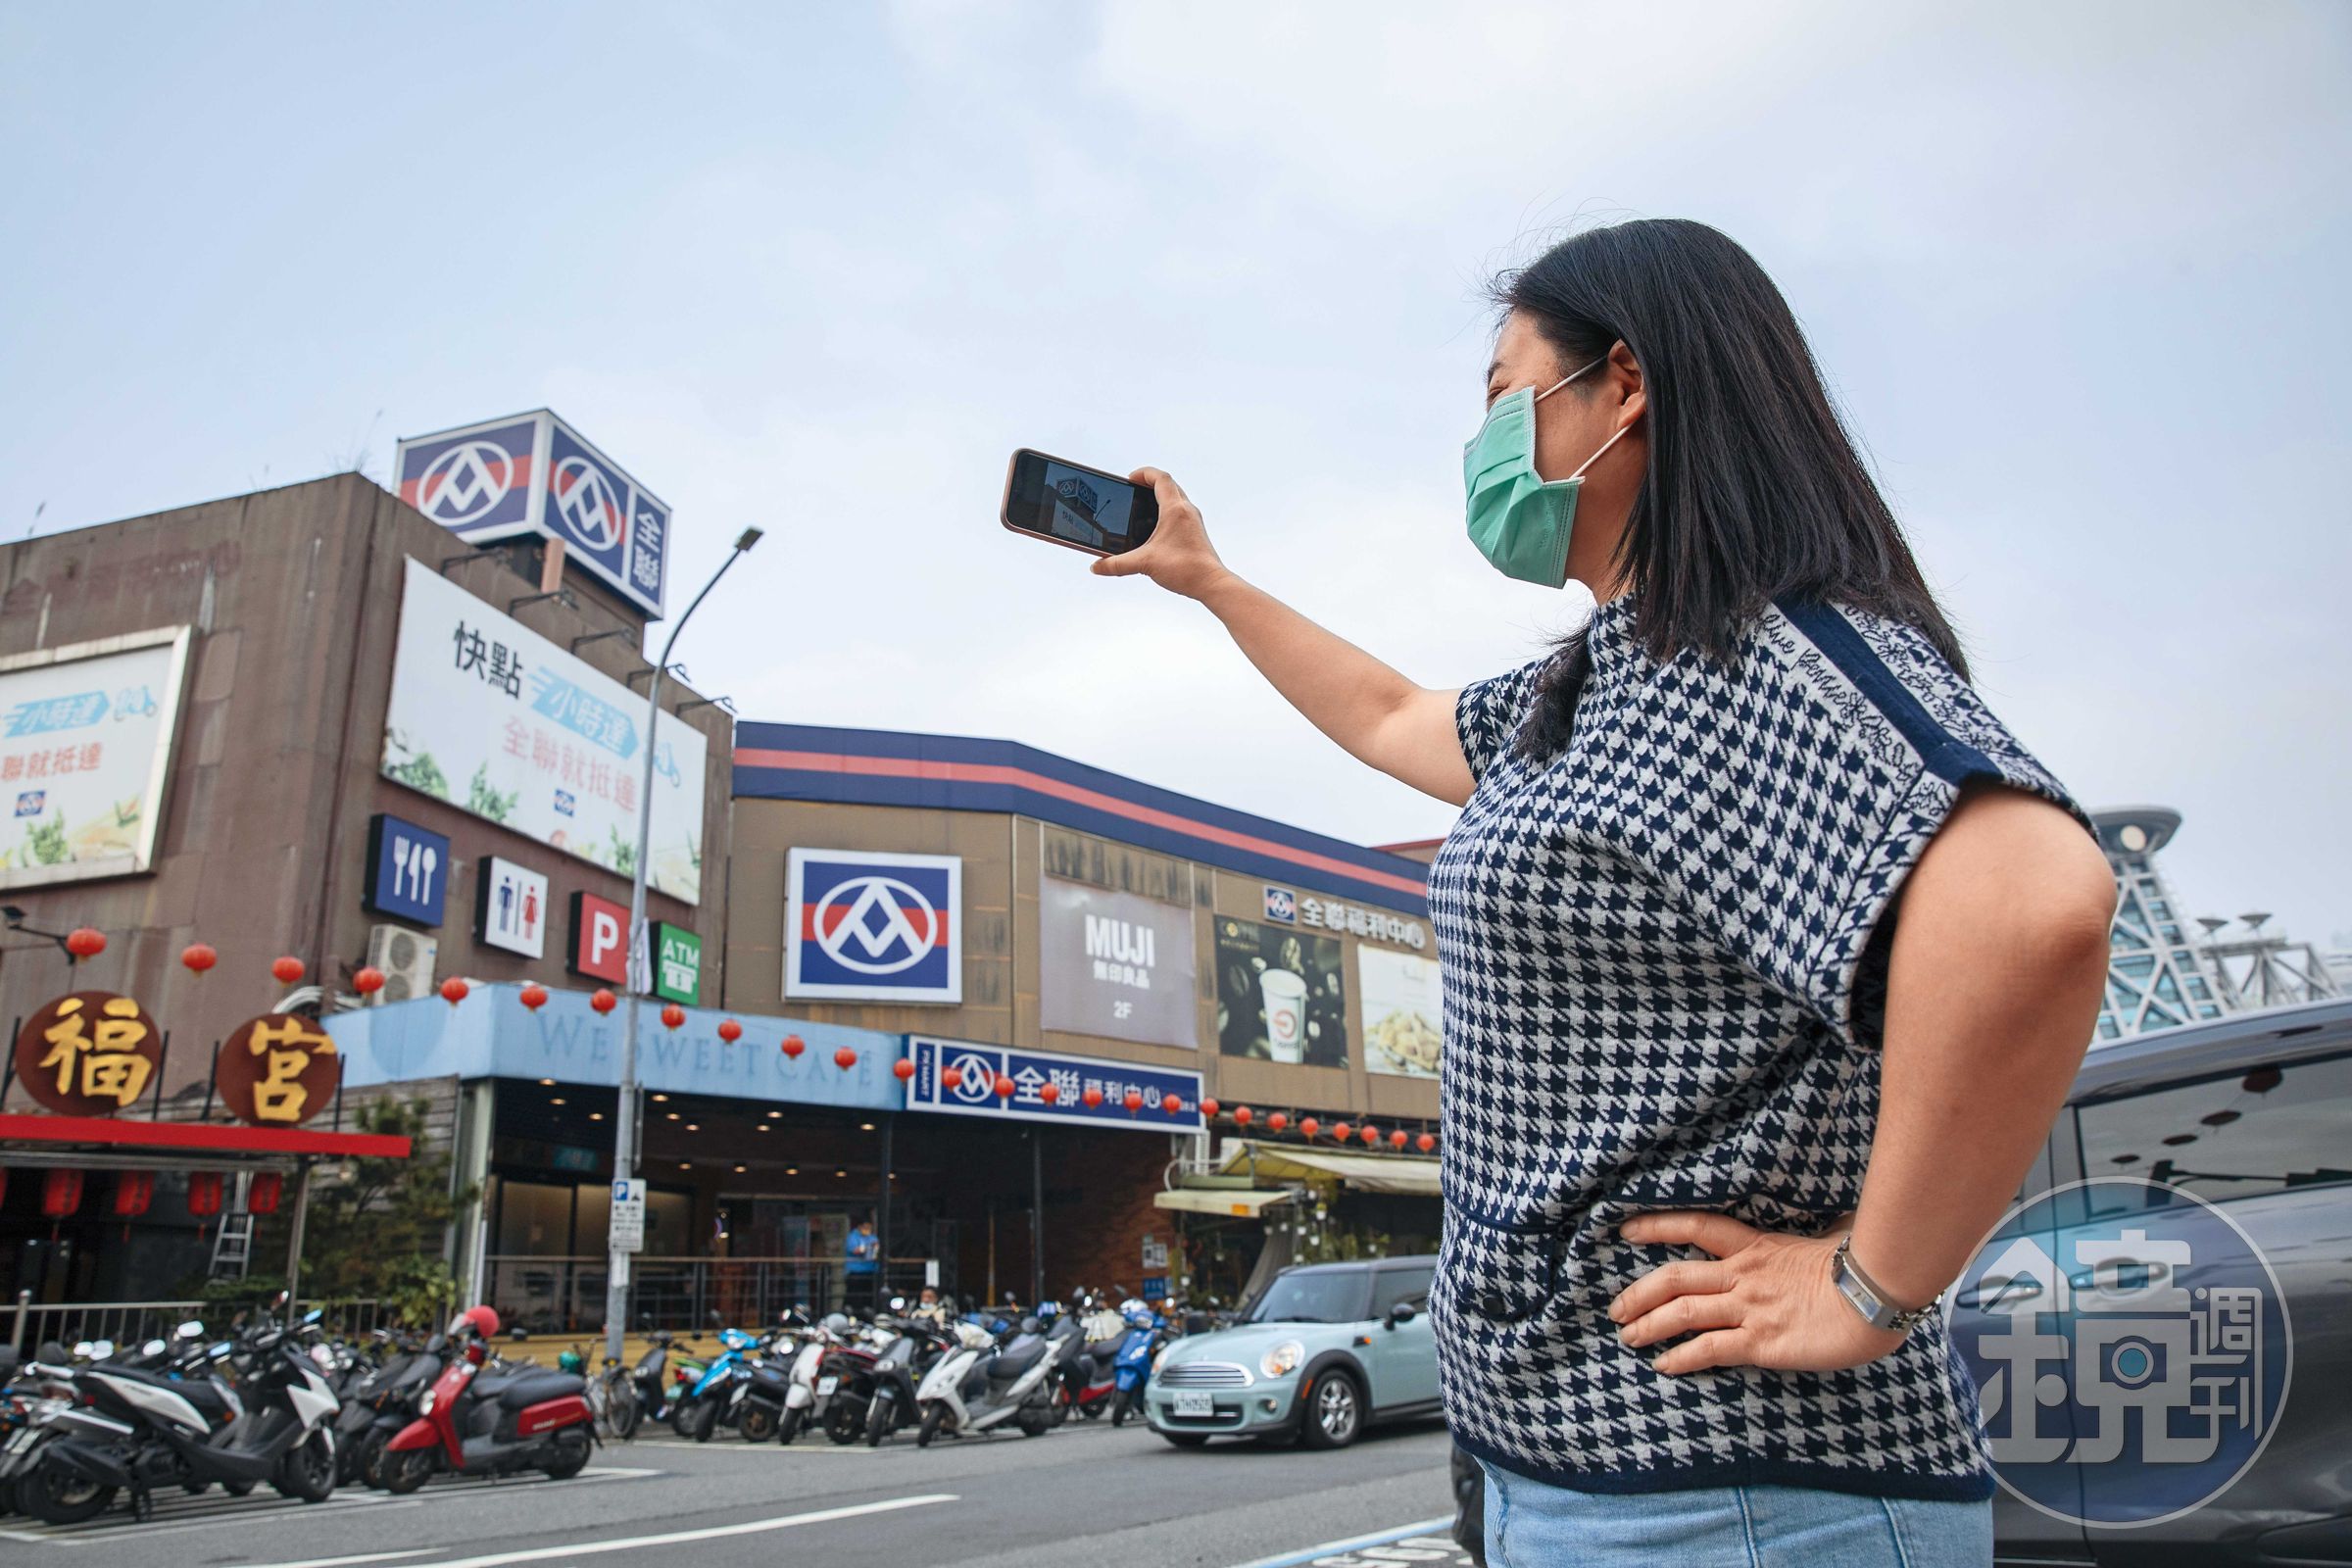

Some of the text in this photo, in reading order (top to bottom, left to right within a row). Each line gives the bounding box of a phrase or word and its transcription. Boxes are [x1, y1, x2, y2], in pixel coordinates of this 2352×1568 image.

[633, 512, 662, 590] 全聯
[454, 620, 523, 700] 快點
[502, 713, 637, 812] 全聯就抵達
[591, 910, 619, 965] P
[1085, 914, 1154, 967] MUJI
[1300, 898, 1426, 950] 全聯福利中心
[662, 938, 700, 969] ATM
[1113, 1001, 1133, 1019] 2F
[39, 998, 336, 1121] 福 宮
[538, 1013, 608, 1062] WE
